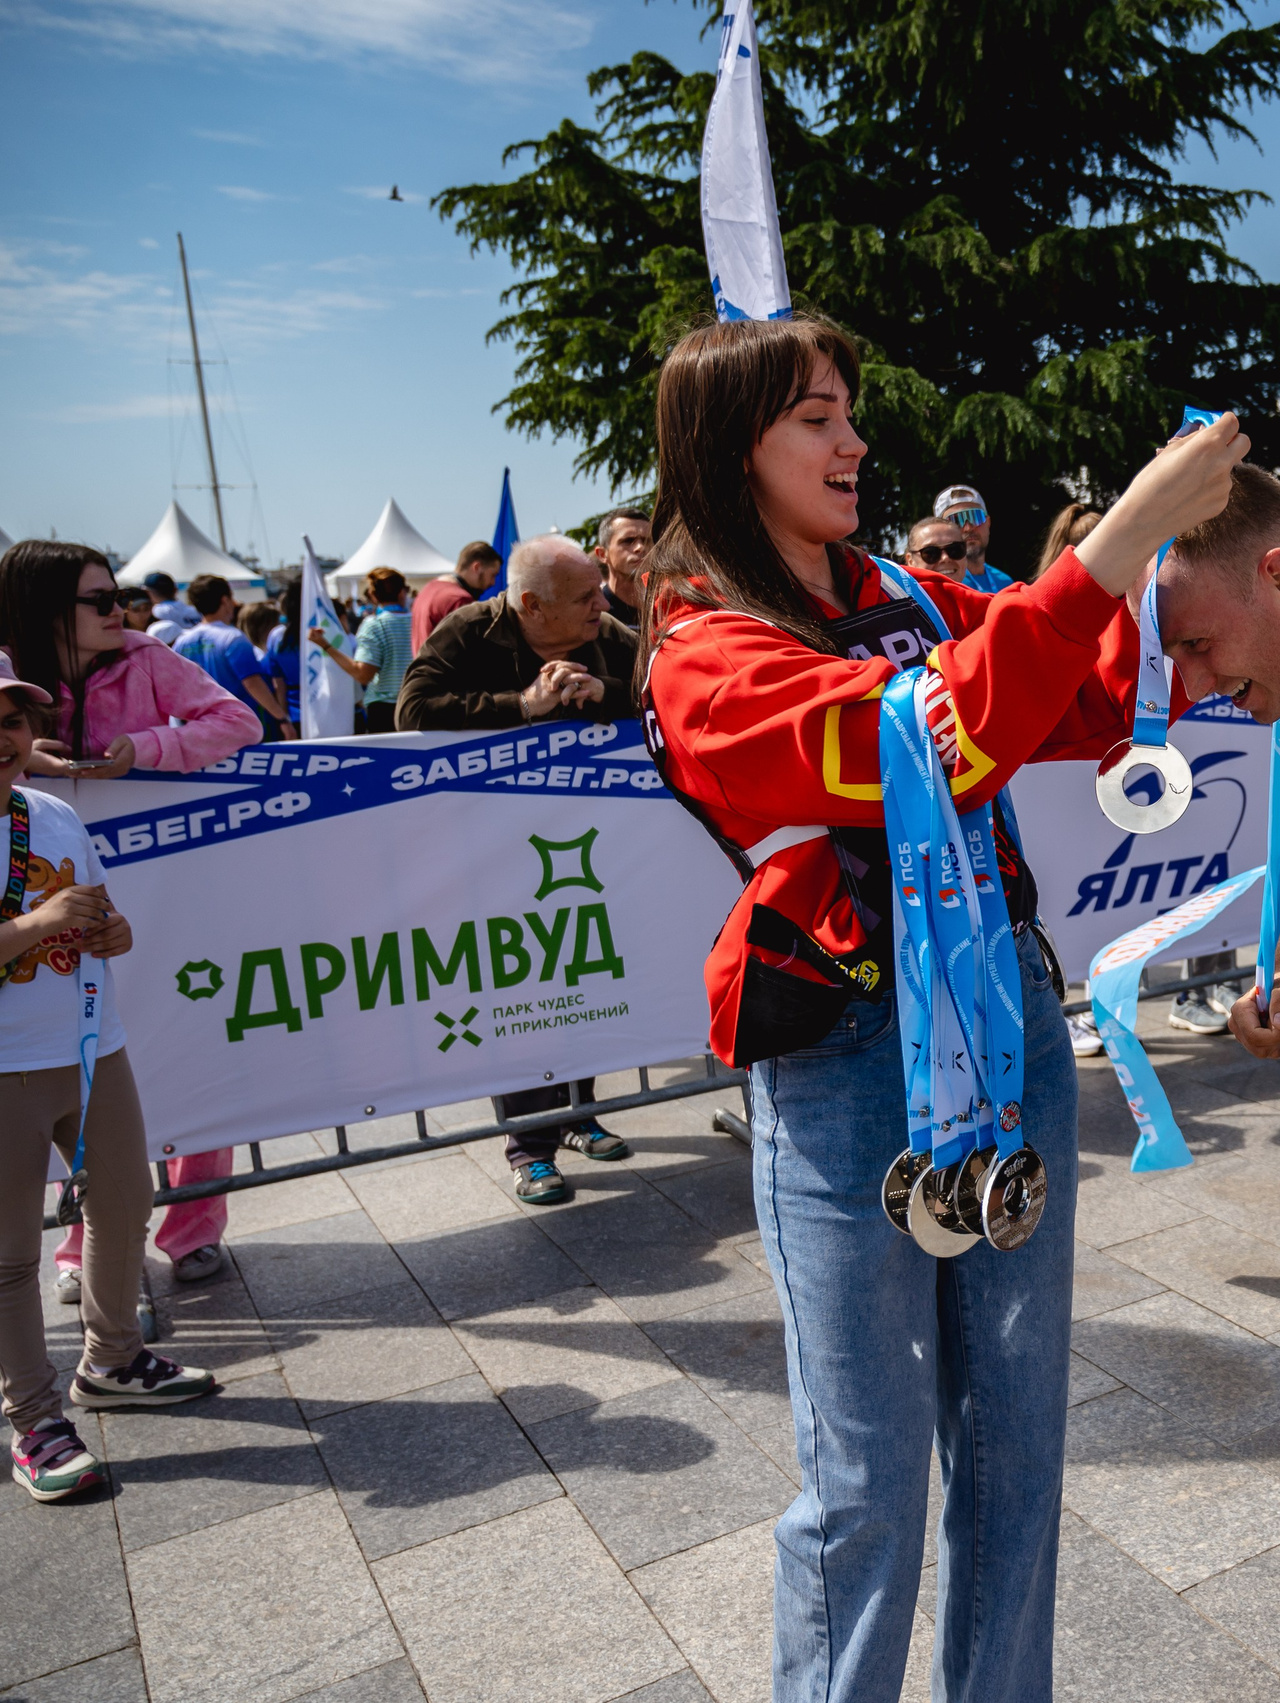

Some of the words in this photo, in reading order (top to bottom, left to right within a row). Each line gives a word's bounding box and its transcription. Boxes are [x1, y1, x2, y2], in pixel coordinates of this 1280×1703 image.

[881, 698, 898, 721] ОСТОРГ
[200, 751, 376, 777] БЕГ.Р
[390, 722, 618, 791] ЗАБЕГ.РФ
[11, 811, 29, 854] LOVE
[967, 829, 988, 869] ПСБ
[6, 856, 27, 903] LOVE
[897, 841, 915, 881] ПСБ
[941, 843, 954, 884] ПСБ
[1066, 852, 1229, 917] ЯЛТА
[225, 902, 625, 1043] ДРИМВУД
[84, 996, 95, 1019] ПСБ
[493, 1002, 534, 1019] ПАРК
[538, 993, 585, 1011] ЧУДЕС
[495, 1025, 507, 1038] И
[511, 1002, 630, 1035] ПРИКЛЮЧЕНИЙ
